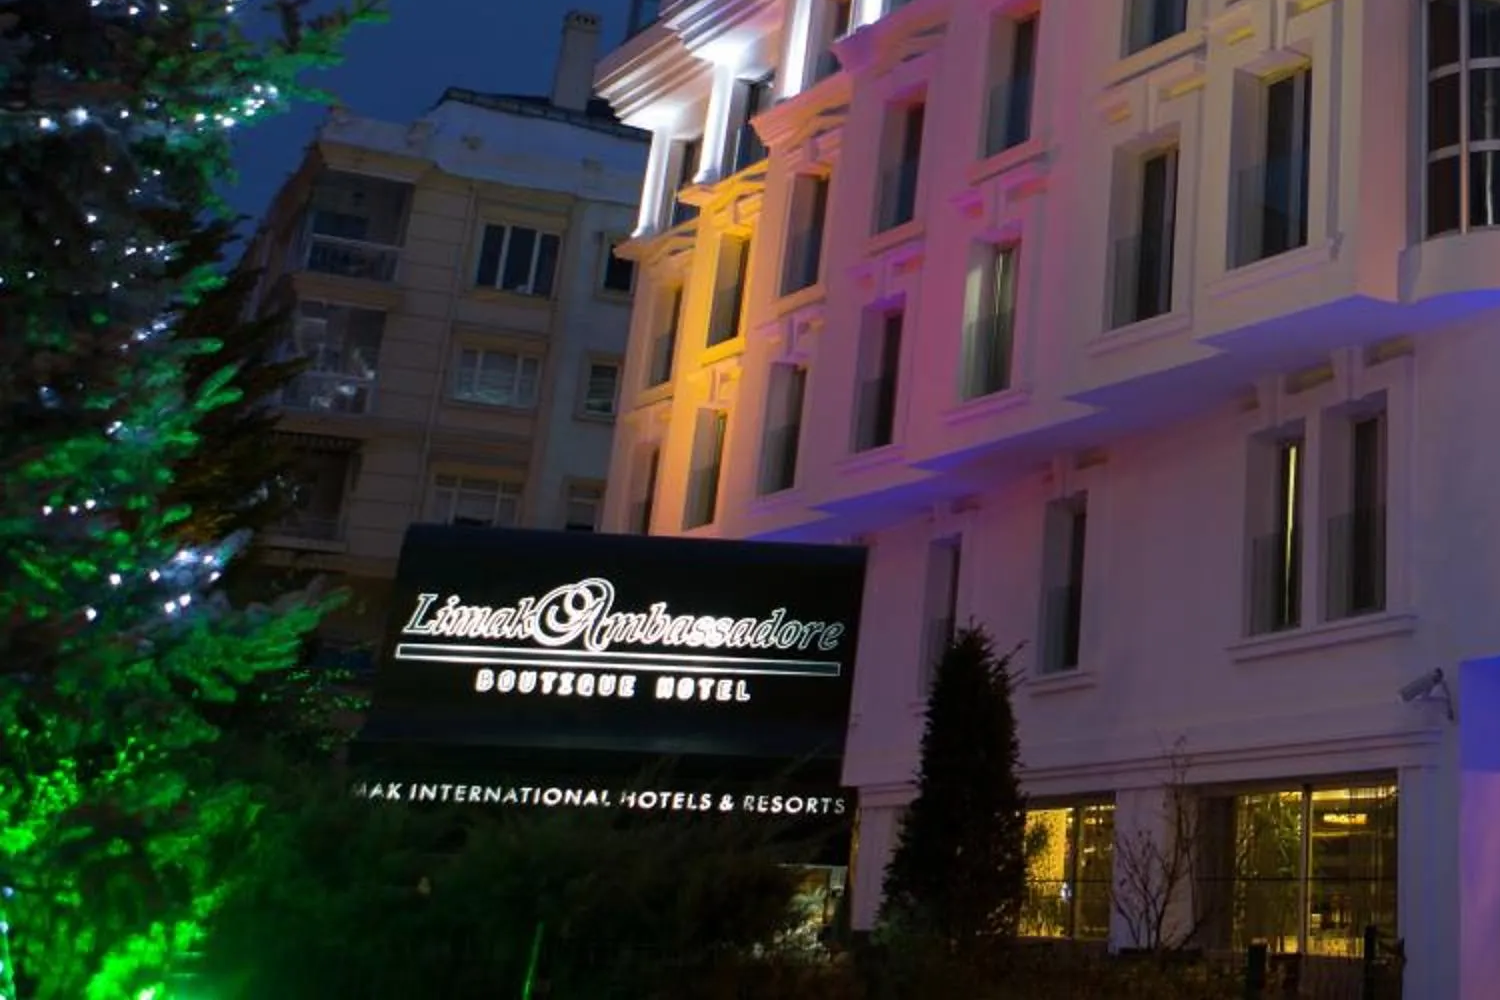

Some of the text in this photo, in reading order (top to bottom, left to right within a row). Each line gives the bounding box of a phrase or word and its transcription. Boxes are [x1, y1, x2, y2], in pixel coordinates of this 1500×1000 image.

[403, 577, 844, 652] Limak Ambassadore
[475, 669, 750, 701] BOUTIQUE HOTEL
[408, 784, 612, 806] INTERNATIONAL
[620, 790, 712, 811] HOTELS
[719, 795, 734, 812] &
[743, 795, 846, 815] RESORTS
